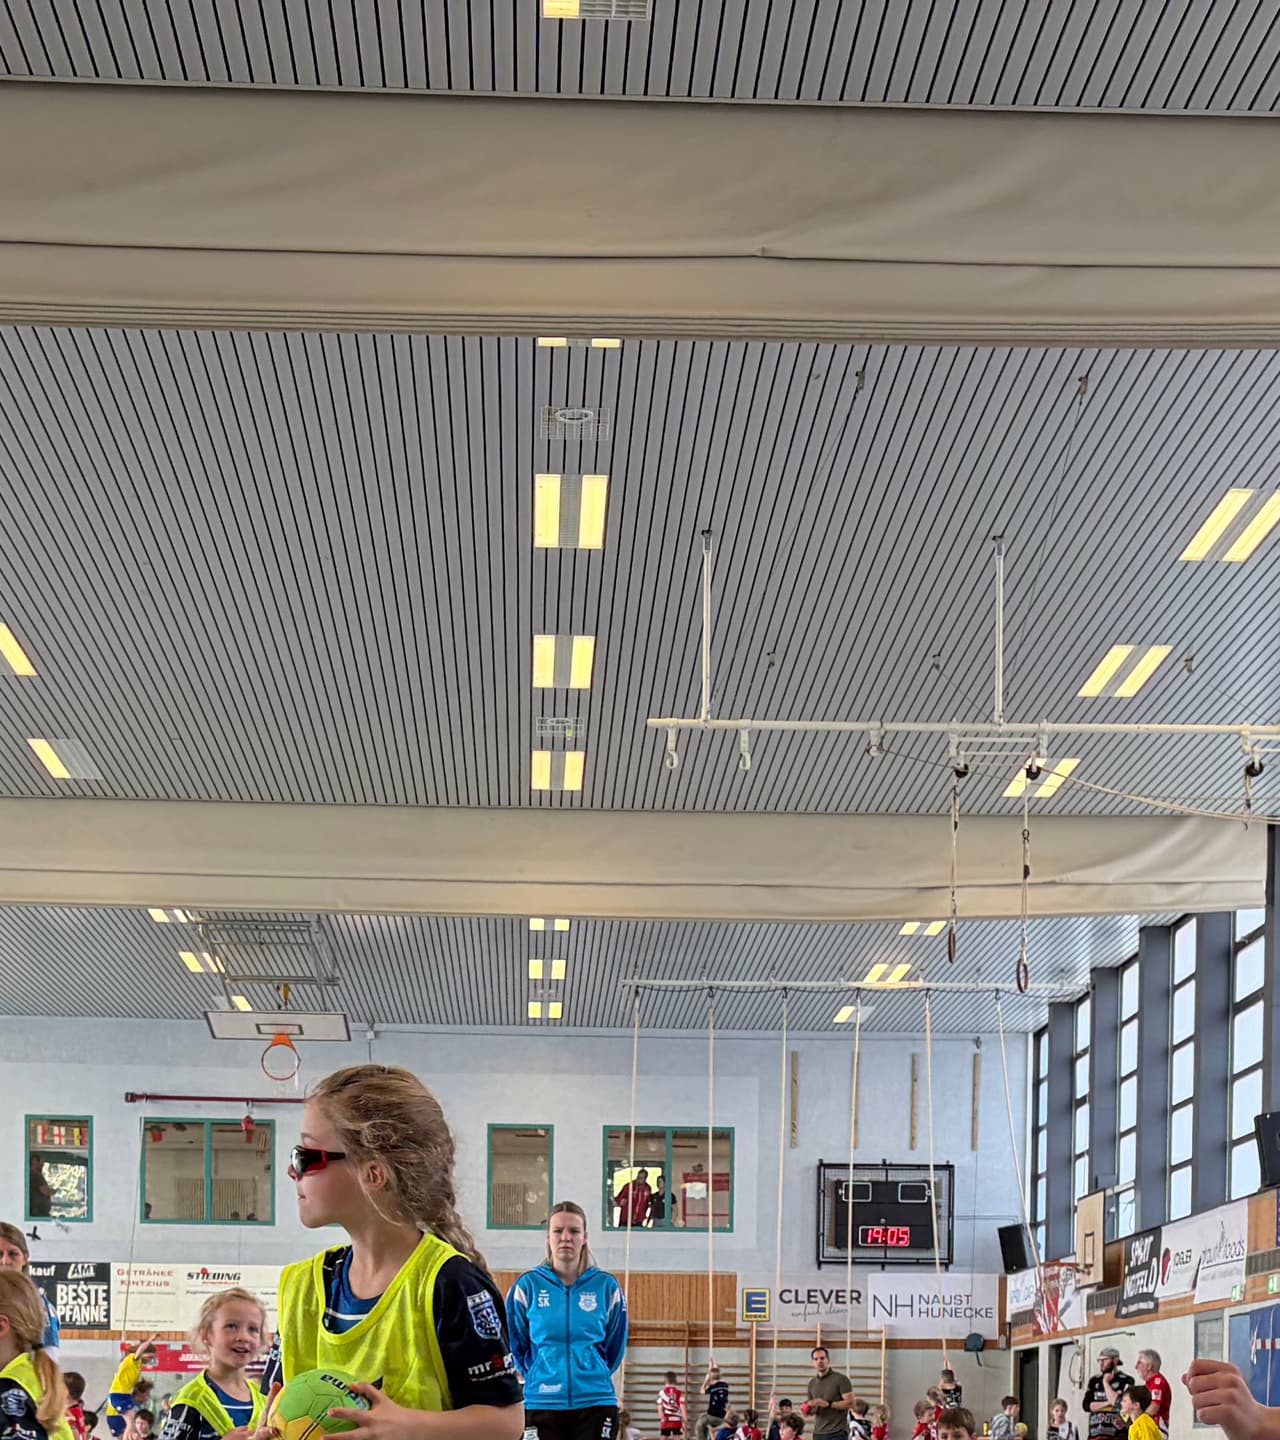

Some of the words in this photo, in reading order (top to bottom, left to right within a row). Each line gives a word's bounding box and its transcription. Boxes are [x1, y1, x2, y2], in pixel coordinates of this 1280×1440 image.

[866, 1228, 909, 1245] 19:05
[116, 1268, 174, 1278] GETRÄNKE
[57, 1284, 109, 1306] BESTE
[537, 1298, 551, 1308] SK
[779, 1289, 862, 1304] CLEVER
[872, 1294, 914, 1318] NH
[918, 1294, 972, 1305] NAUST
[918, 1307, 993, 1319] HUNECKE
[57, 1305, 109, 1324] PFANNE
